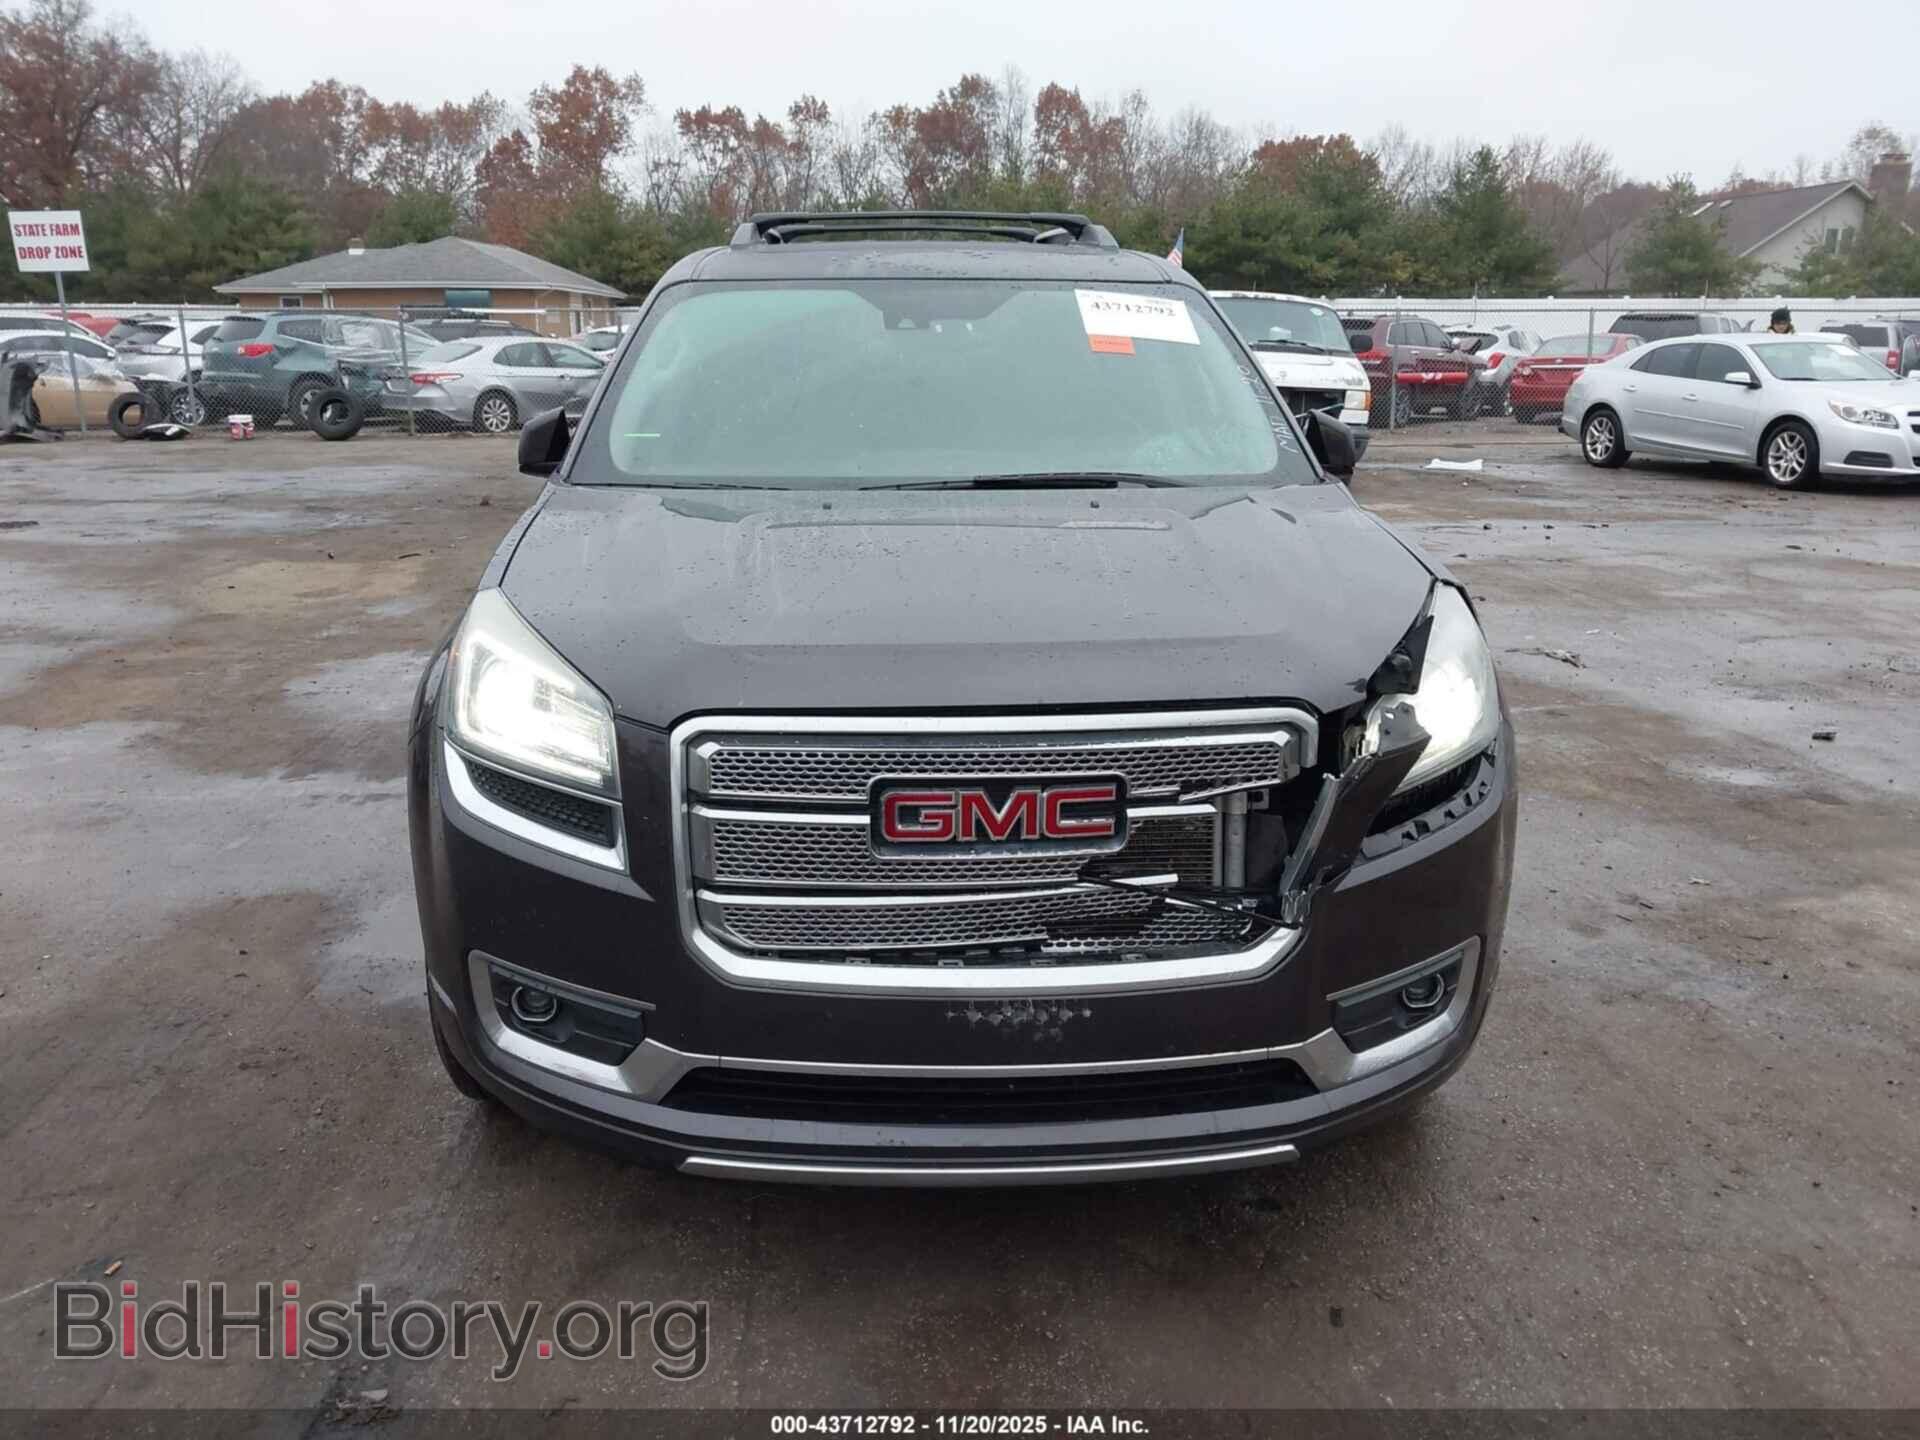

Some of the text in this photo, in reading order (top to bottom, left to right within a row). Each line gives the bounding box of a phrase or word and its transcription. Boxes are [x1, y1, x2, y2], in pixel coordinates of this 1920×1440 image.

[14, 223, 80, 236] STATE FARM
[17, 246, 84, 259] DROP ZONE
[882, 786, 1116, 842] GMC
